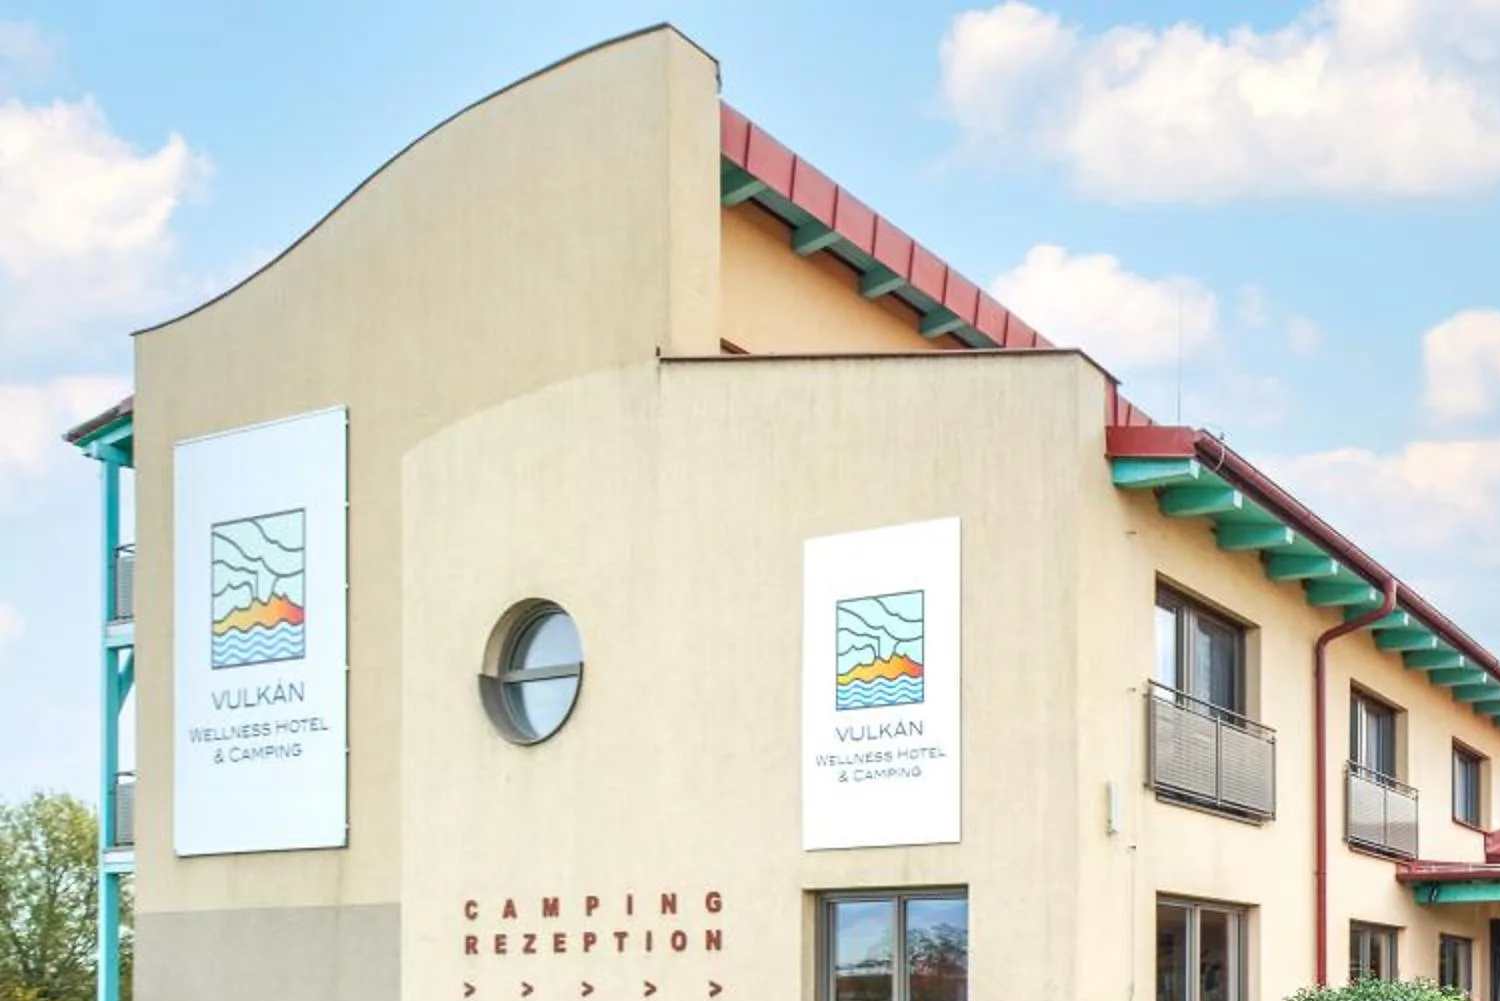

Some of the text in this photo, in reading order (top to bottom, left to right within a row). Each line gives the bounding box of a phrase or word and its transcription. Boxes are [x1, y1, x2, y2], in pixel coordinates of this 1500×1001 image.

[211, 677, 305, 710] VULKÁN
[189, 716, 329, 744] WELLNESS HOTEL
[835, 716, 924, 743] VULKÁN
[214, 742, 303, 765] & CAMPING
[815, 746, 947, 768] WELLNESS HOTEL
[838, 764, 922, 784] & CAMPING
[463, 891, 723, 921] CAMPING
[464, 929, 723, 955] REZEPTION
